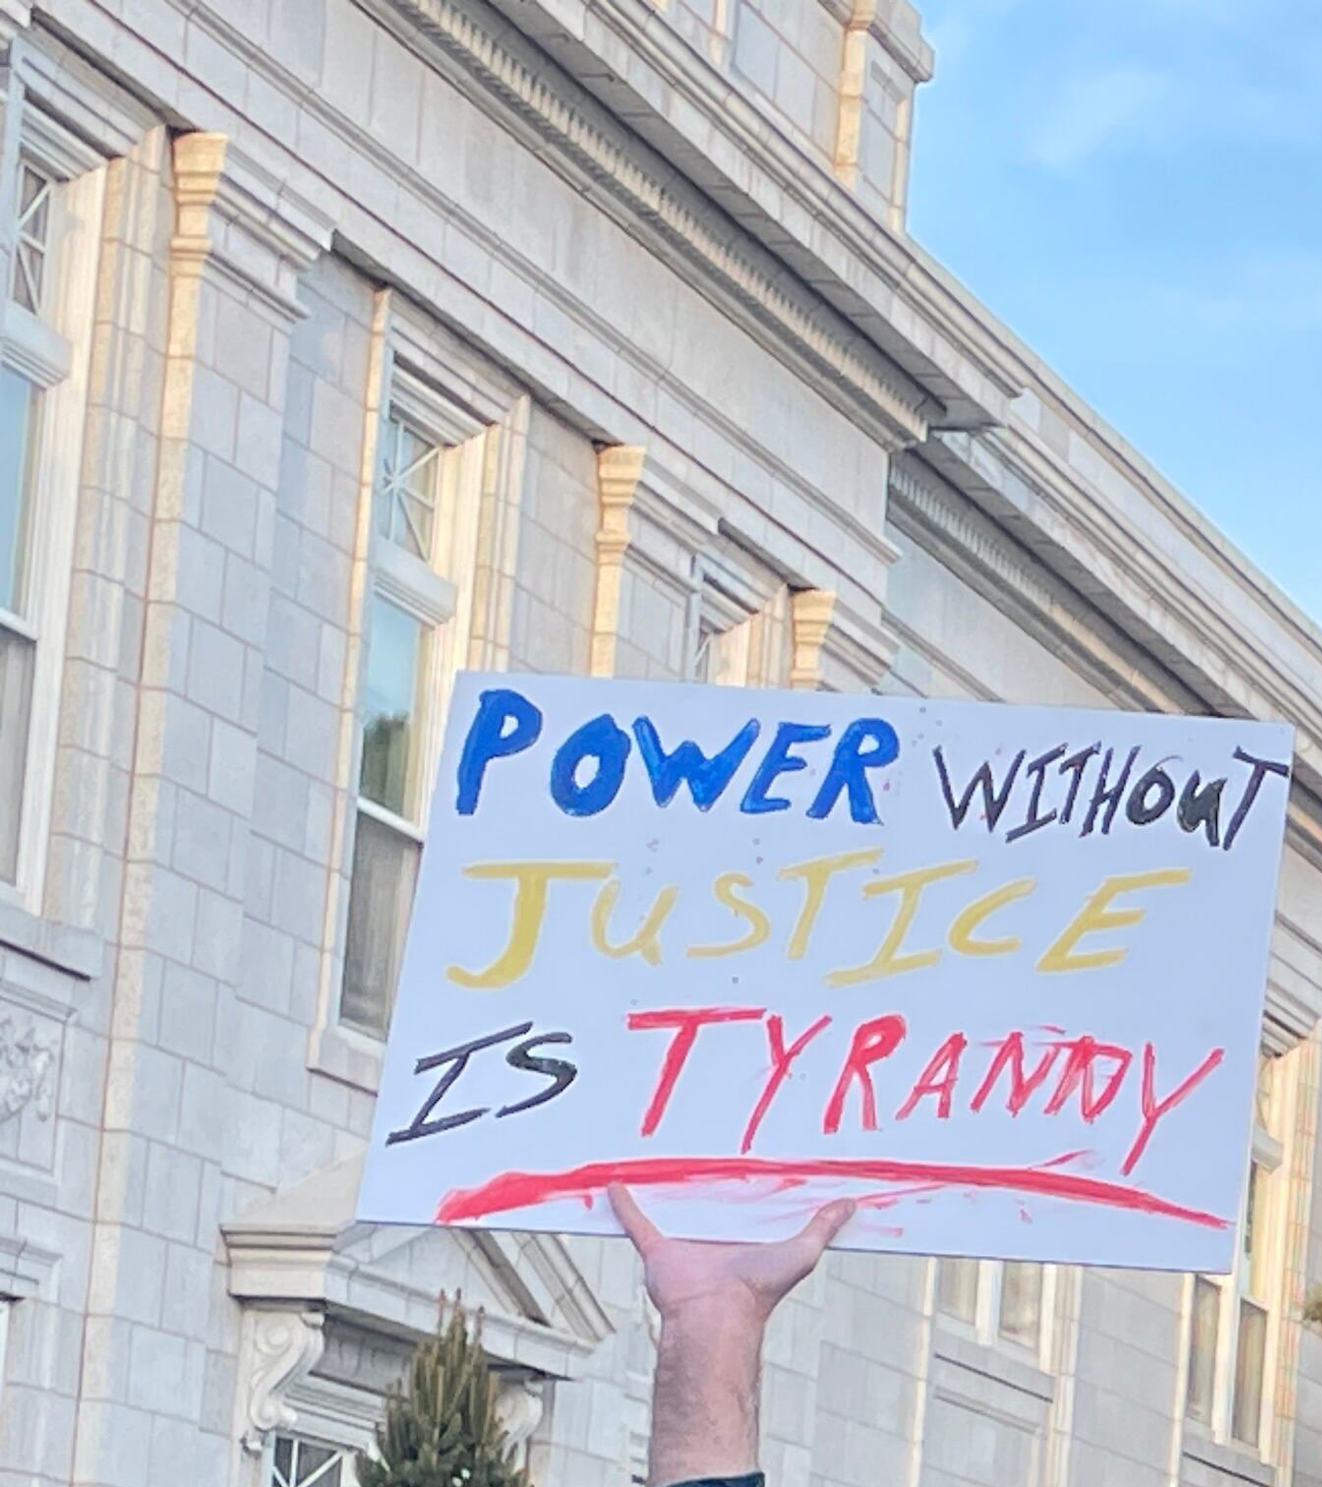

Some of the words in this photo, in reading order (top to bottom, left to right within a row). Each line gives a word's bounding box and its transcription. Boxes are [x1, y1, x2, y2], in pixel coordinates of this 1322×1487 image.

[456, 688, 899, 826] POWER
[385, 1020, 578, 1147] IS
[626, 1006, 1225, 1176] TYRANNY
